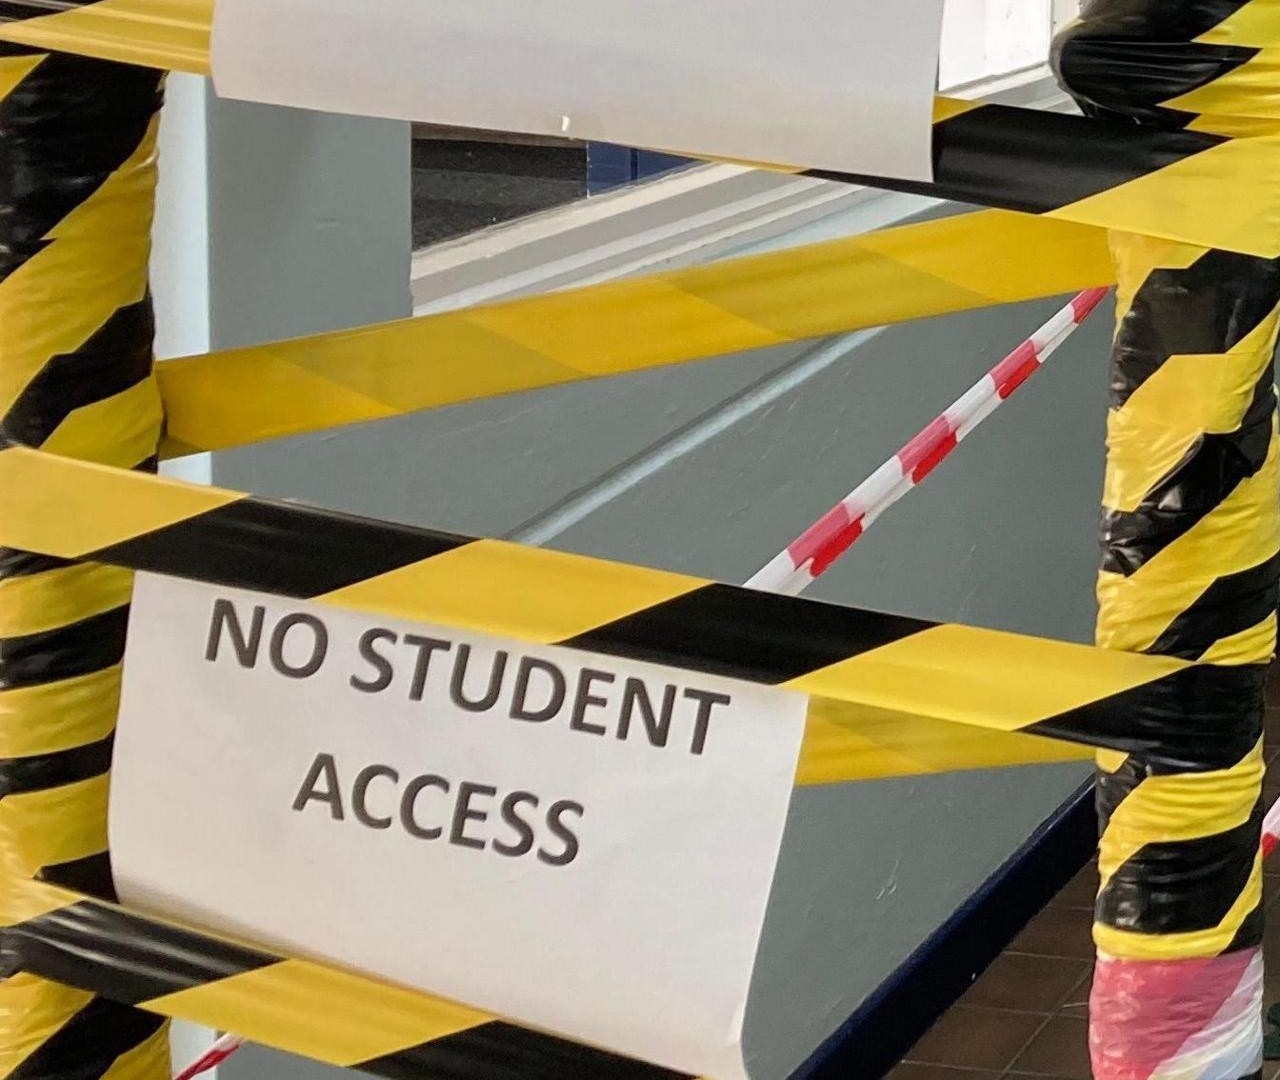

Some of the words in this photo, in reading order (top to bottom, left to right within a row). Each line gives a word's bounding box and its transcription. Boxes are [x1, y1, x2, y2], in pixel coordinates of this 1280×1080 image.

[204, 597, 329, 680] NO
[348, 627, 732, 756] STUDENT
[290, 752, 586, 867] ACCESS
